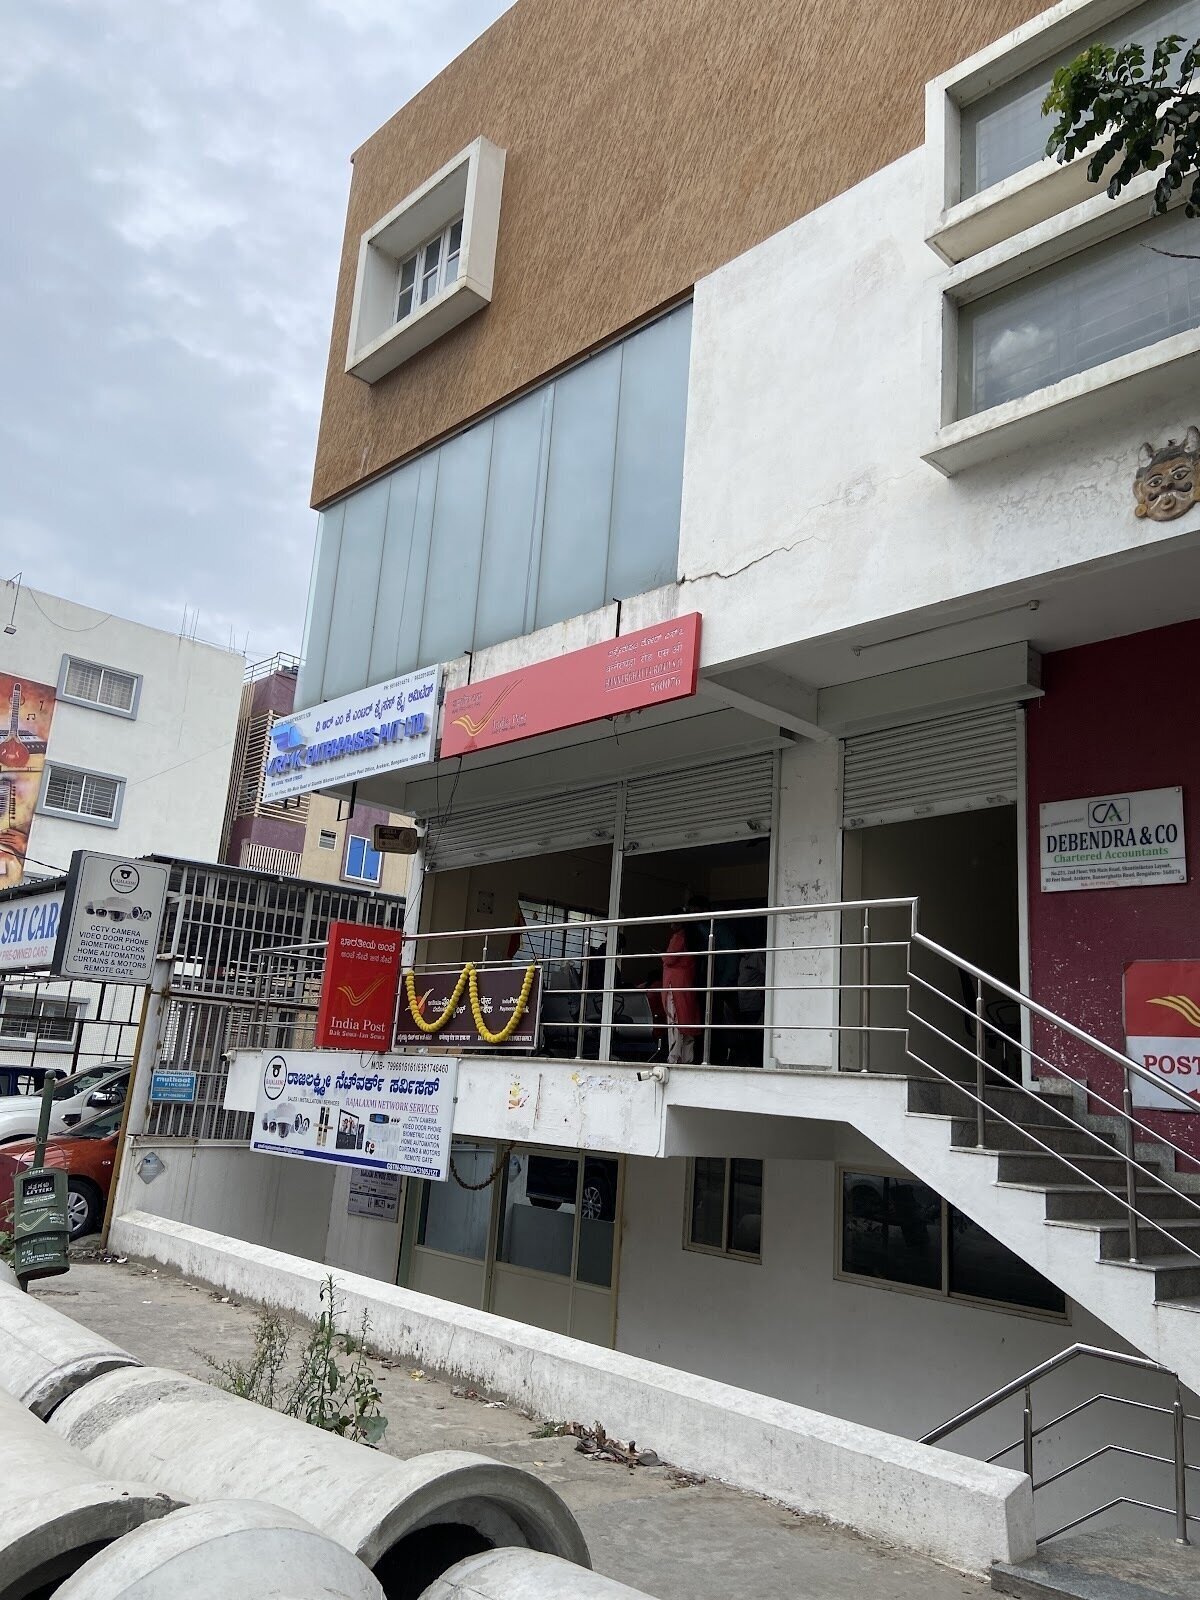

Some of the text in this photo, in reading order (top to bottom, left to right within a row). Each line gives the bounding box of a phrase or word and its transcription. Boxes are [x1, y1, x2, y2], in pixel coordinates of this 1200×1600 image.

[305, 727, 376, 765] ENTERPRISES
[379, 719, 401, 744] PVT
[404, 712, 426, 737] LTD
[1046, 824, 1178, 853] DEBENDRA & CO
[1054, 847, 1169, 863] Chartered Accountants
[1, 902, 58, 944] SAI CAR
[90, 924, 141, 937] CCTV CAMERA
[80, 931, 149, 946] VIDEO DOOR PHONE
[341, 938, 376, 949] ಭಾರತೀಯ
[33, 945, 48, 958] CARS
[80, 940, 145, 953] BIOMETRIC LOCKS
[73, 955, 109, 966] CURTAINS
[117, 960, 147, 969] MOTORS
[100, 950, 146, 961] AUTOMATION
[84, 964, 134, 976] REMOTE GATE
[331, 1017, 385, 1032] India Post
[1143, 1055, 1200, 1075] POST
[390, 1077, 440, 1096] ಸರ್ವಿಸಸ್
[345, 1097, 439, 1114] RAJALAXMI NETWORK SERVICES
[403, 1131, 424, 1139] BIOMETRIC
[413, 1140, 440, 1148] AUTOMATION
[399, 1145, 418, 1153] CURTAINS
[422, 1149, 440, 1157] MOTORS
[26, 1187, 53, 1196] LETTERS
